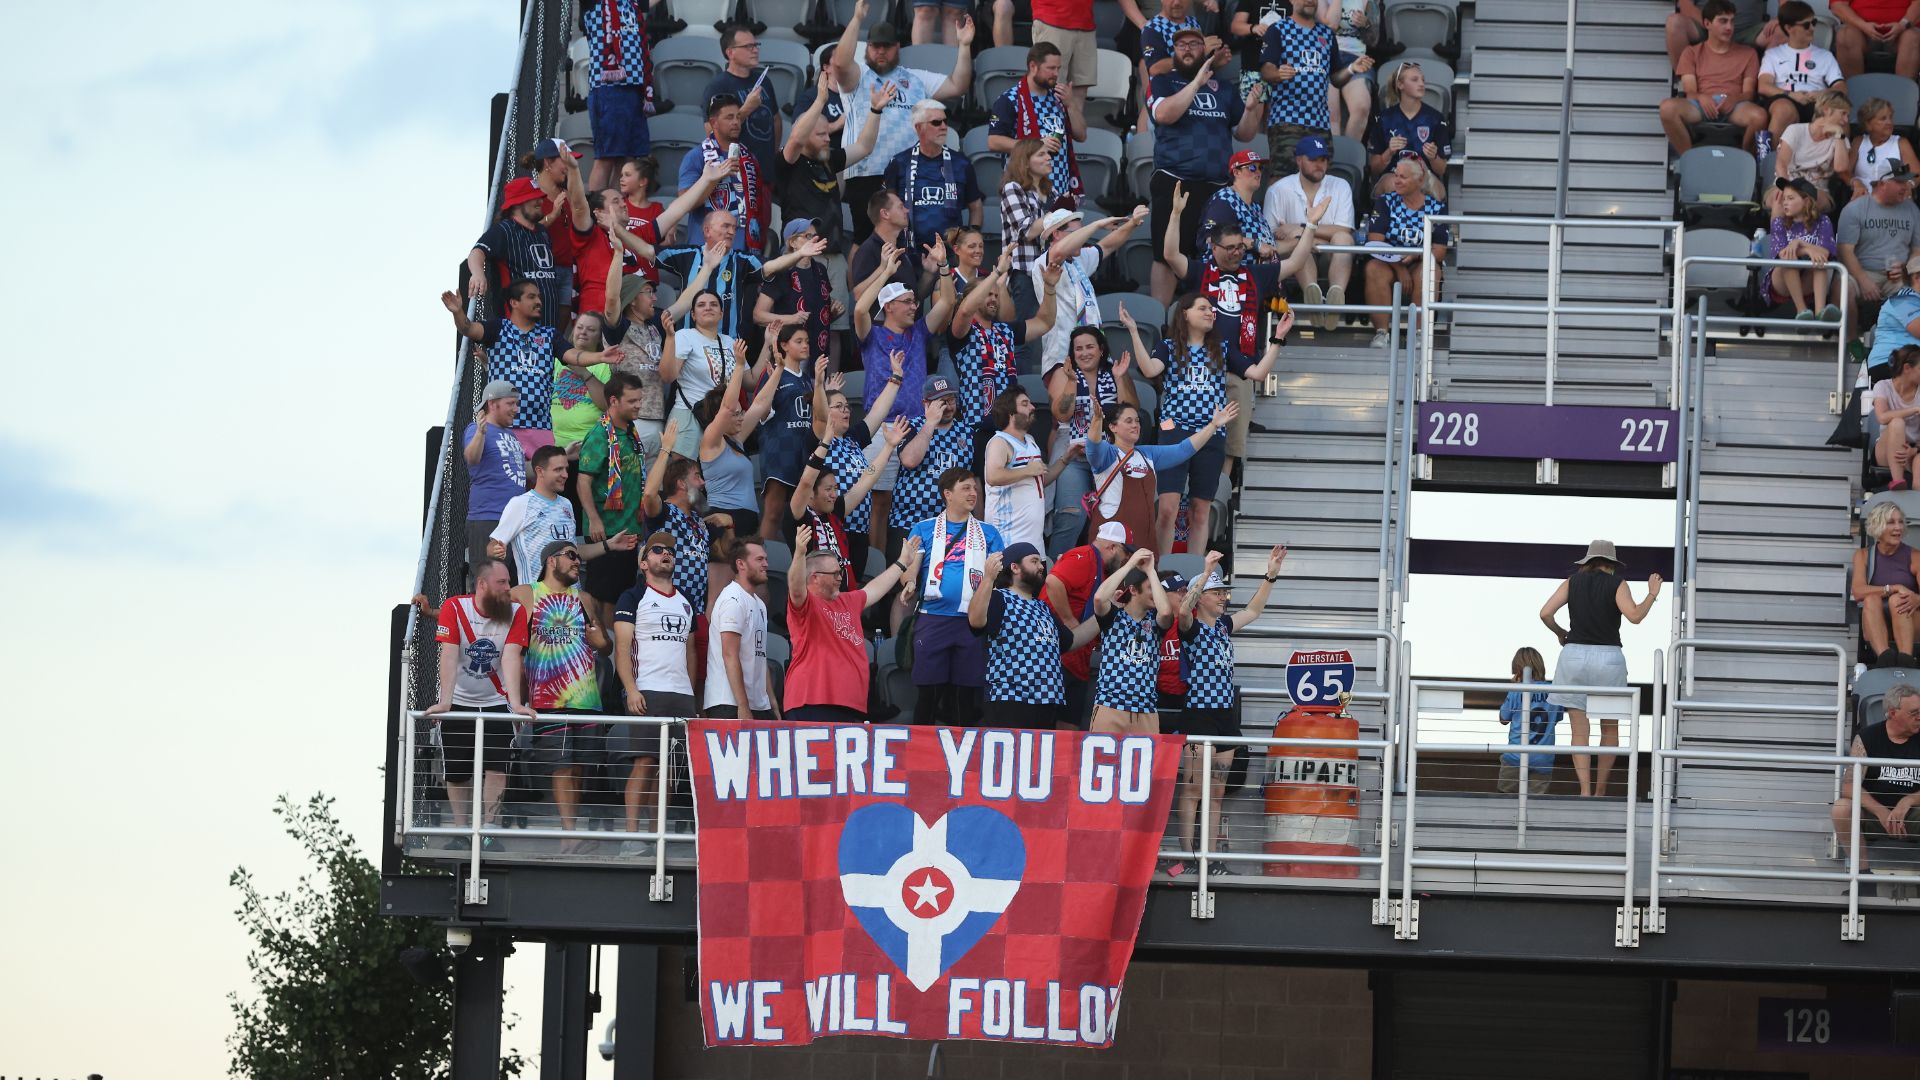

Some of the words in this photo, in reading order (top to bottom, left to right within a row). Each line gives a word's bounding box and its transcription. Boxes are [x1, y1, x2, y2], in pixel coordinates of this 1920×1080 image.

[1189, 109, 1227, 118] HONDA
[1864, 218, 1911, 231] LOUISVILLE
[523, 271, 556, 279] HON
[786, 421, 812, 430] HON
[1428, 411, 1479, 447] 228
[1620, 418, 1669, 452] 227
[536, 626, 579, 636] GRATEFU
[1297, 653, 1345, 664] INTERSTATE
[1296, 669, 1344, 702] 65
[705, 727, 910, 800] WHERE
[936, 728, 1056, 799] YOU
[1078, 734, 1155, 804] GO
[708, 980, 785, 1040] WE
[804, 972, 908, 1035] WILL
[1783, 1008, 1831, 1044] 128
